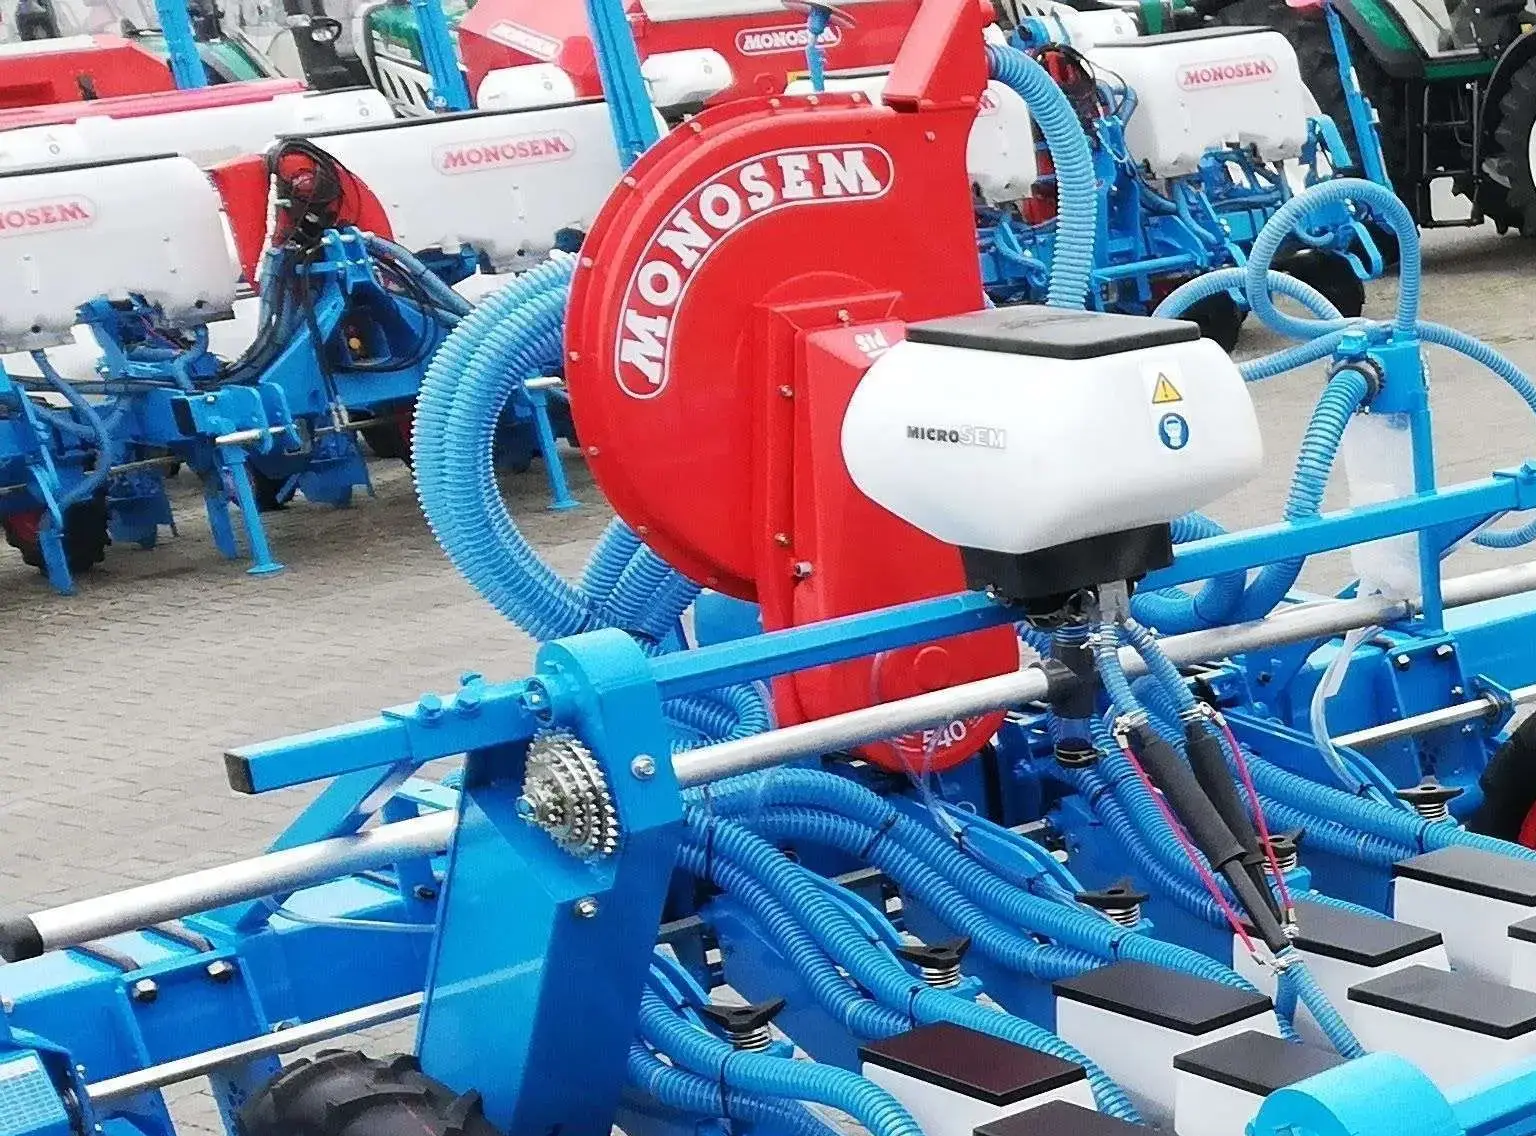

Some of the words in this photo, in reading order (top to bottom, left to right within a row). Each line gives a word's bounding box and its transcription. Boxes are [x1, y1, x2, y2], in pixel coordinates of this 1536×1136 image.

[743, 26, 838, 50] MONOSM
[1183, 60, 1272, 85] MONOSEM
[443, 136, 570, 168] MONOSEM
[620, 150, 882, 384] MONOSEM
[907, 425, 1006, 449] MICROSEM
[923, 720, 967, 752] 540
